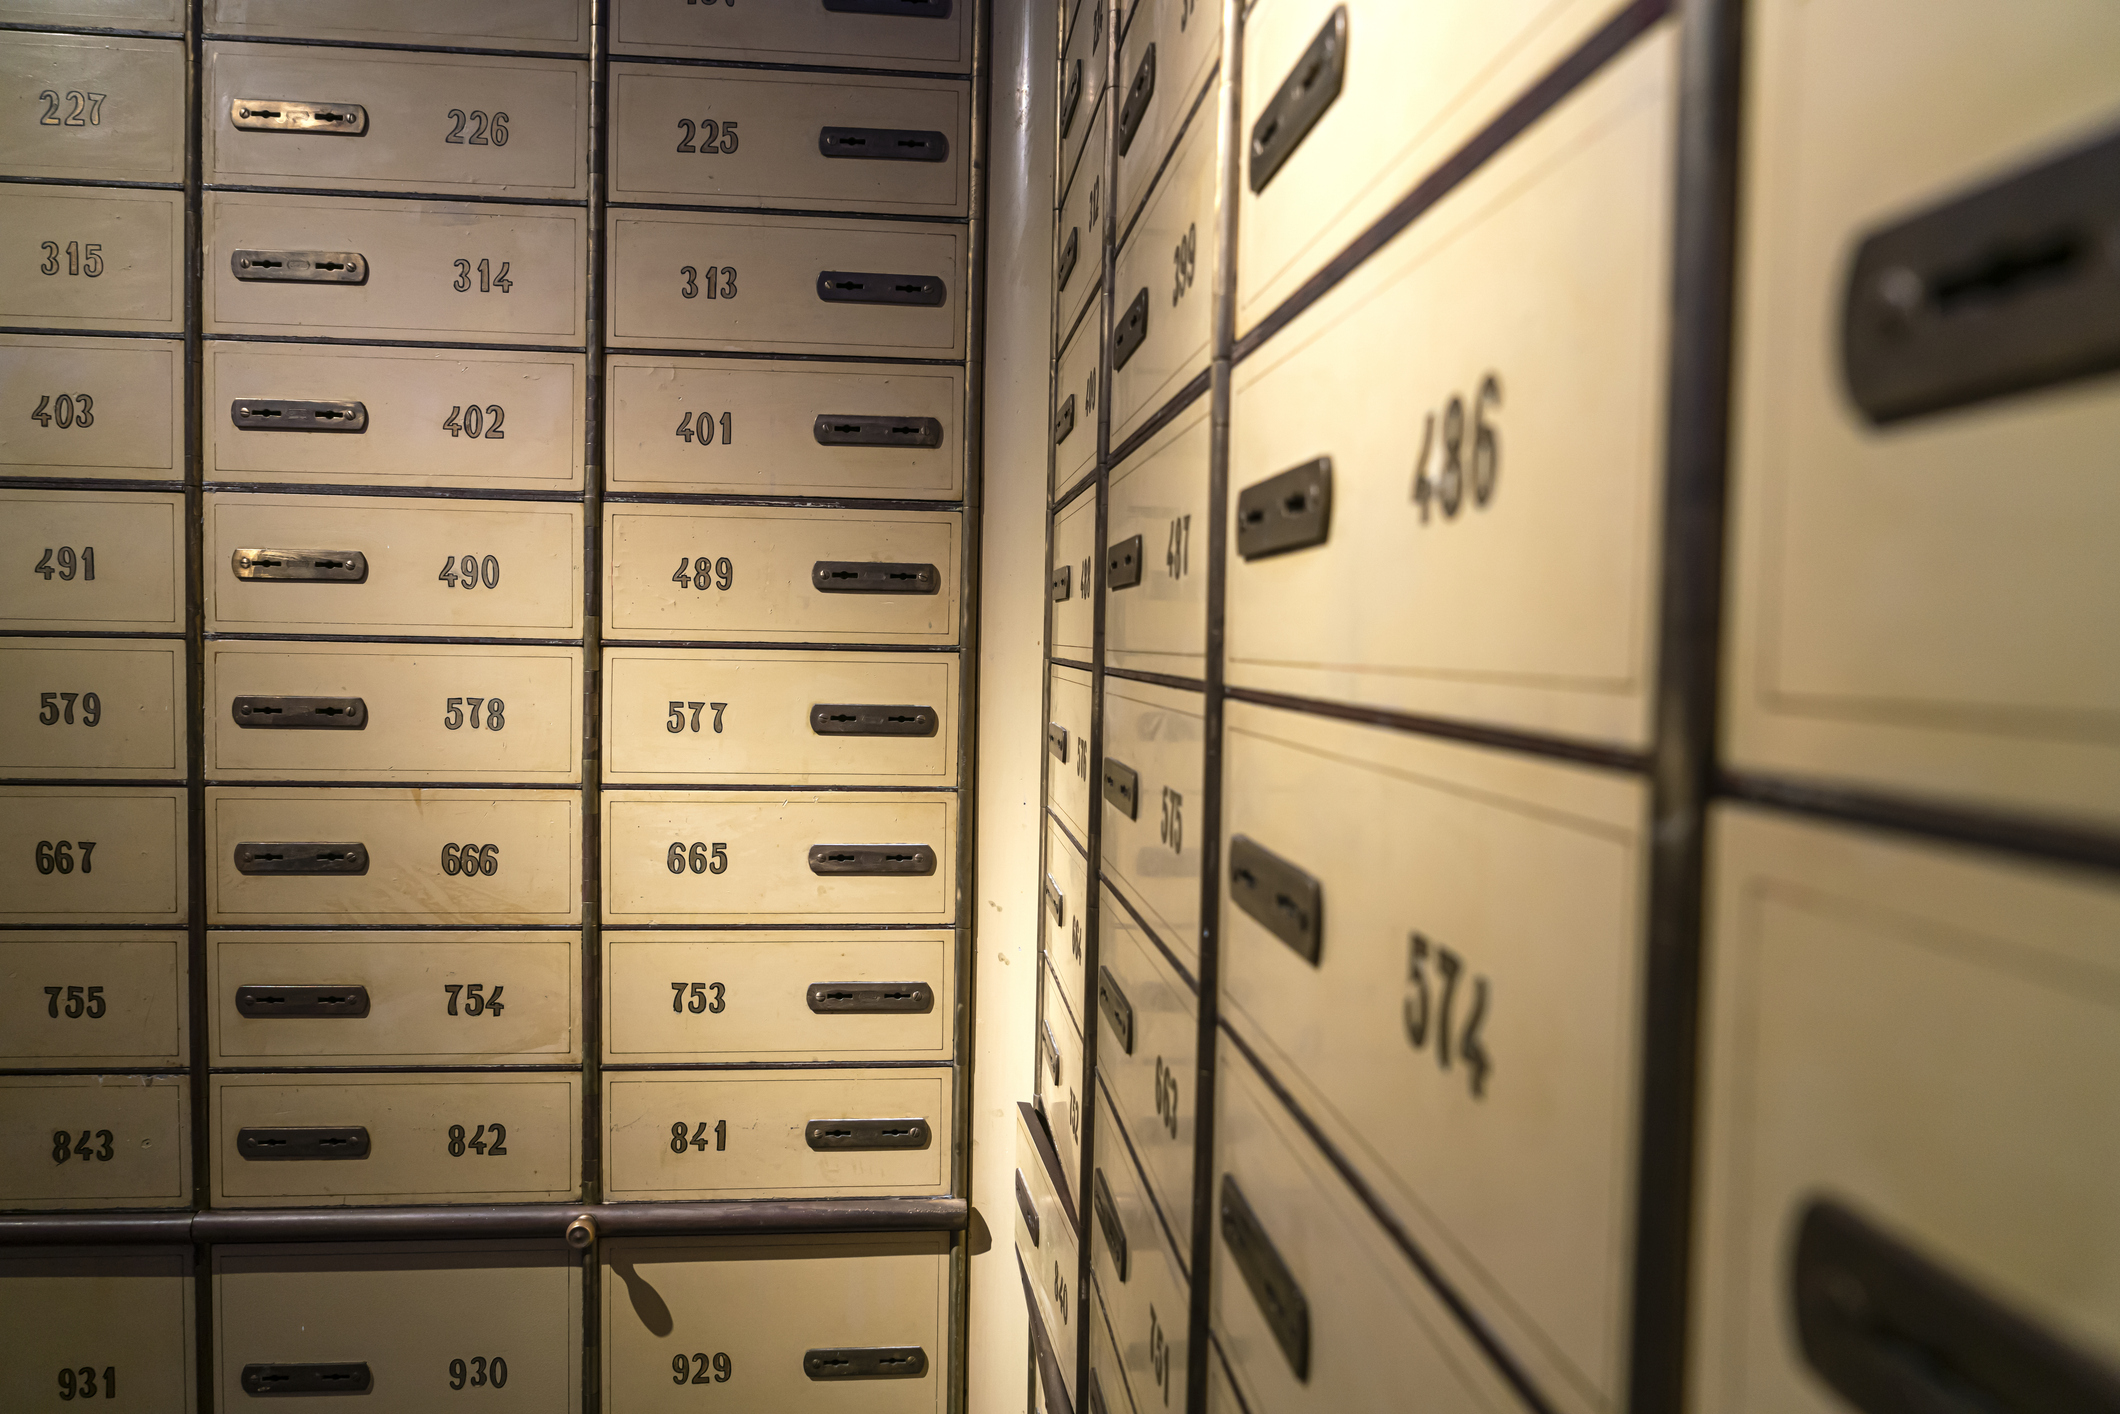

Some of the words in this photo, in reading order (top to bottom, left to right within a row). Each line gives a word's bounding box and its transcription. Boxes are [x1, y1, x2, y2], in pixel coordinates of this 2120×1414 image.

[39, 90, 107, 127] 227
[445, 109, 509, 146] 226
[677, 119, 738, 154] 225
[41, 241, 103, 277] 315
[453, 259, 513, 293] 314
[1172, 223, 1195, 308] 399
[681, 266, 737, 299] 313
[31, 394, 94, 429] 403
[443, 405, 504, 439] 402
[676, 412, 731, 446] 401
[1410, 371, 1504, 526] 486
[35, 546, 95, 581] 491
[1167, 515, 1190, 580] 487
[439, 555, 499, 590] 490
[672, 557, 733, 591] 489
[39, 692, 101, 727] 579
[445, 698, 505, 731] 578
[667, 701, 728, 733] 577
[1076, 736, 1087, 783] 576
[1161, 786, 1182, 855] 575
[36, 840, 96, 875] 667
[441, 843, 499, 877] 666
[667, 842, 727, 874] 665
[1072, 915, 1082, 966] 664
[44, 986, 106, 1019] 755
[445, 984, 504, 1017] 754
[671, 982, 725, 1014] 753
[1403, 931, 1493, 1104] 574
[1156, 1056, 1178, 1140] 663
[1069, 1085, 1079, 1147] 752
[52, 1130, 114, 1163] 843
[448, 1123, 507, 1157] 842
[671, 1120, 726, 1154] 841
[1055, 1260, 1068, 1325] 840
[449, 1356, 507, 1390] 930
[672, 1352, 731, 1385] 929
[1150, 1304, 1170, 1408] 751
[58, 1367, 115, 1401] 931
